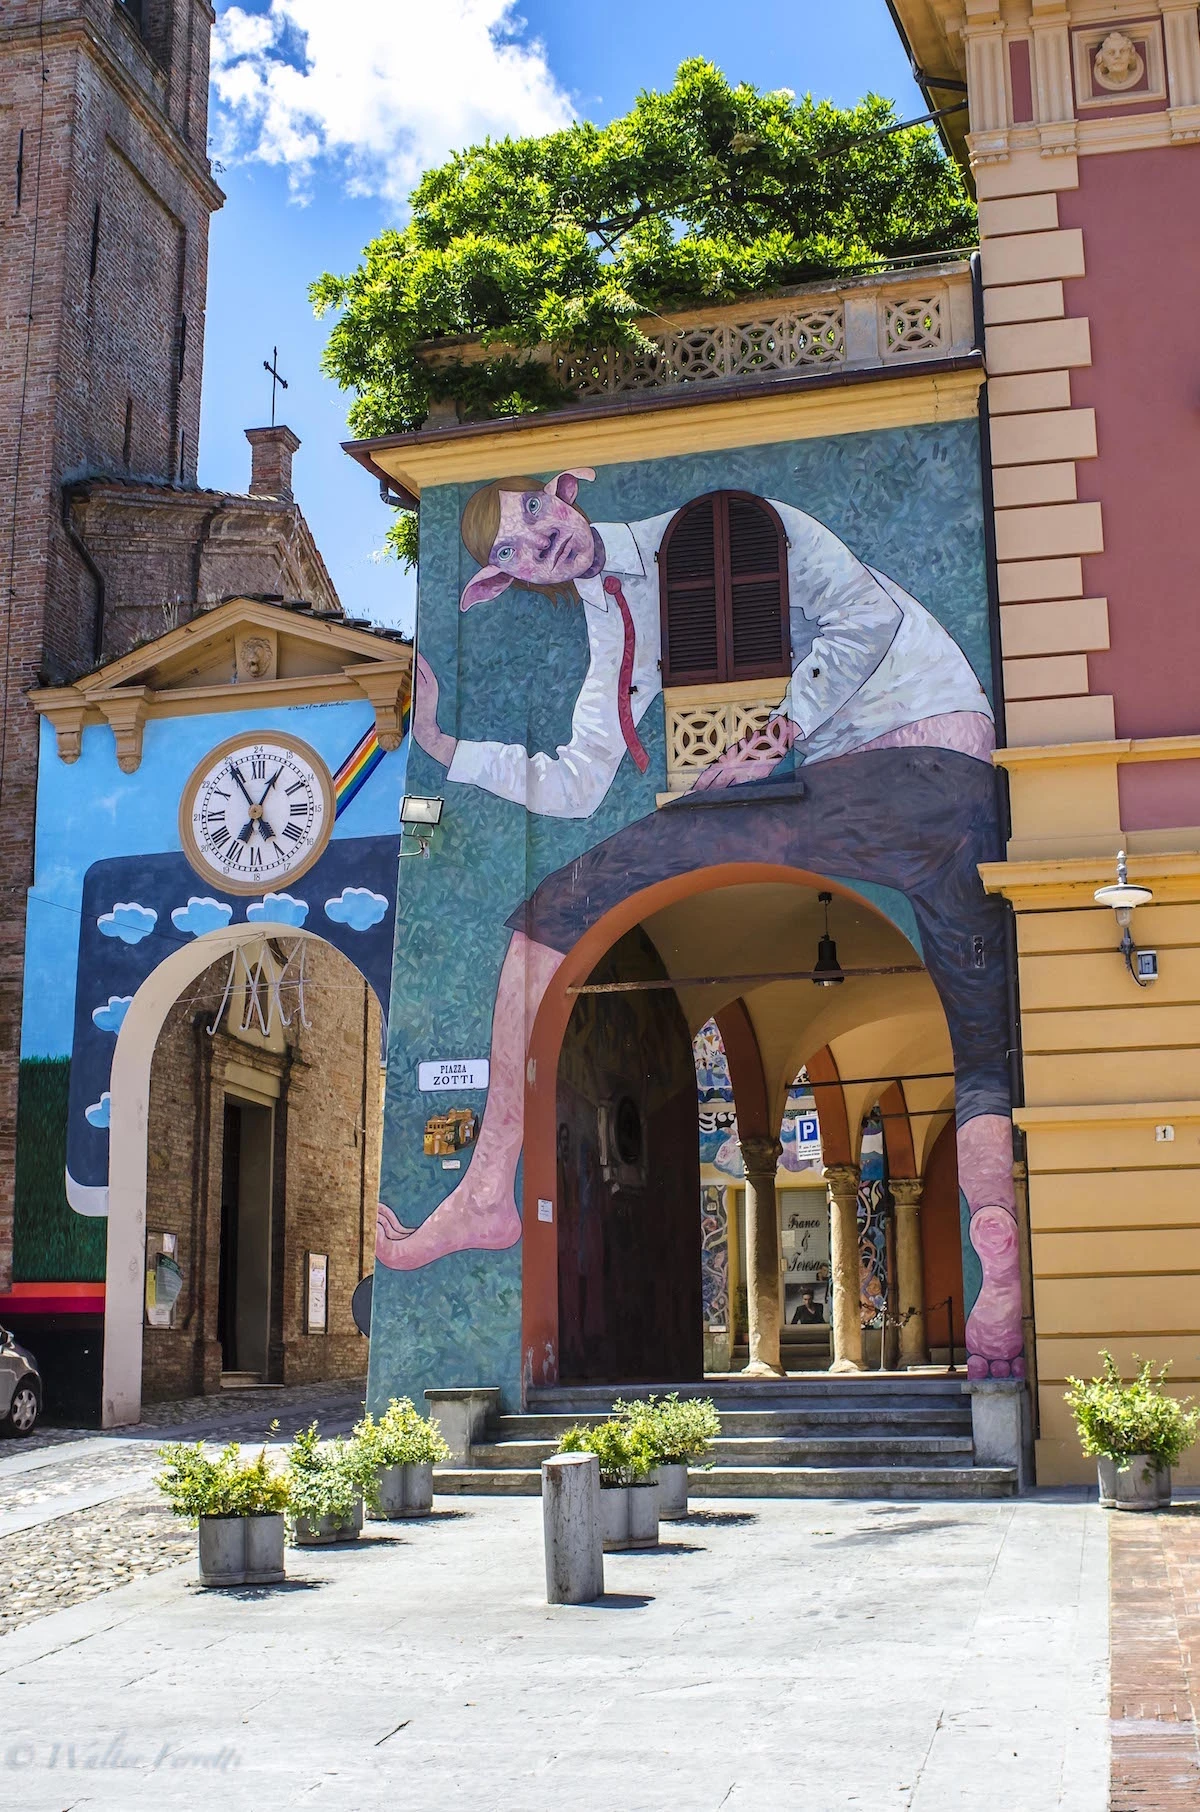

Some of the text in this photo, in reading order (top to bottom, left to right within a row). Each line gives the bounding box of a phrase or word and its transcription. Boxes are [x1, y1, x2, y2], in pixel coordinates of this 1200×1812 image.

[254, 746, 264, 754] 24
[251, 760, 266, 780] XII
[289, 803, 308, 816] III
[315, 805, 322, 813] 15
[284, 863, 291, 871] 17
[253, 873, 260, 881] 18
[440, 1064, 467, 1074] PIAZZA
[433, 1074, 474, 1086] ZOTTI
[802, 1121, 815, 1140] P
[1161, 1126, 1167, 1139] 1
[788, 1213, 820, 1229] Franco
[788, 1252, 821, 1272] Teresa
